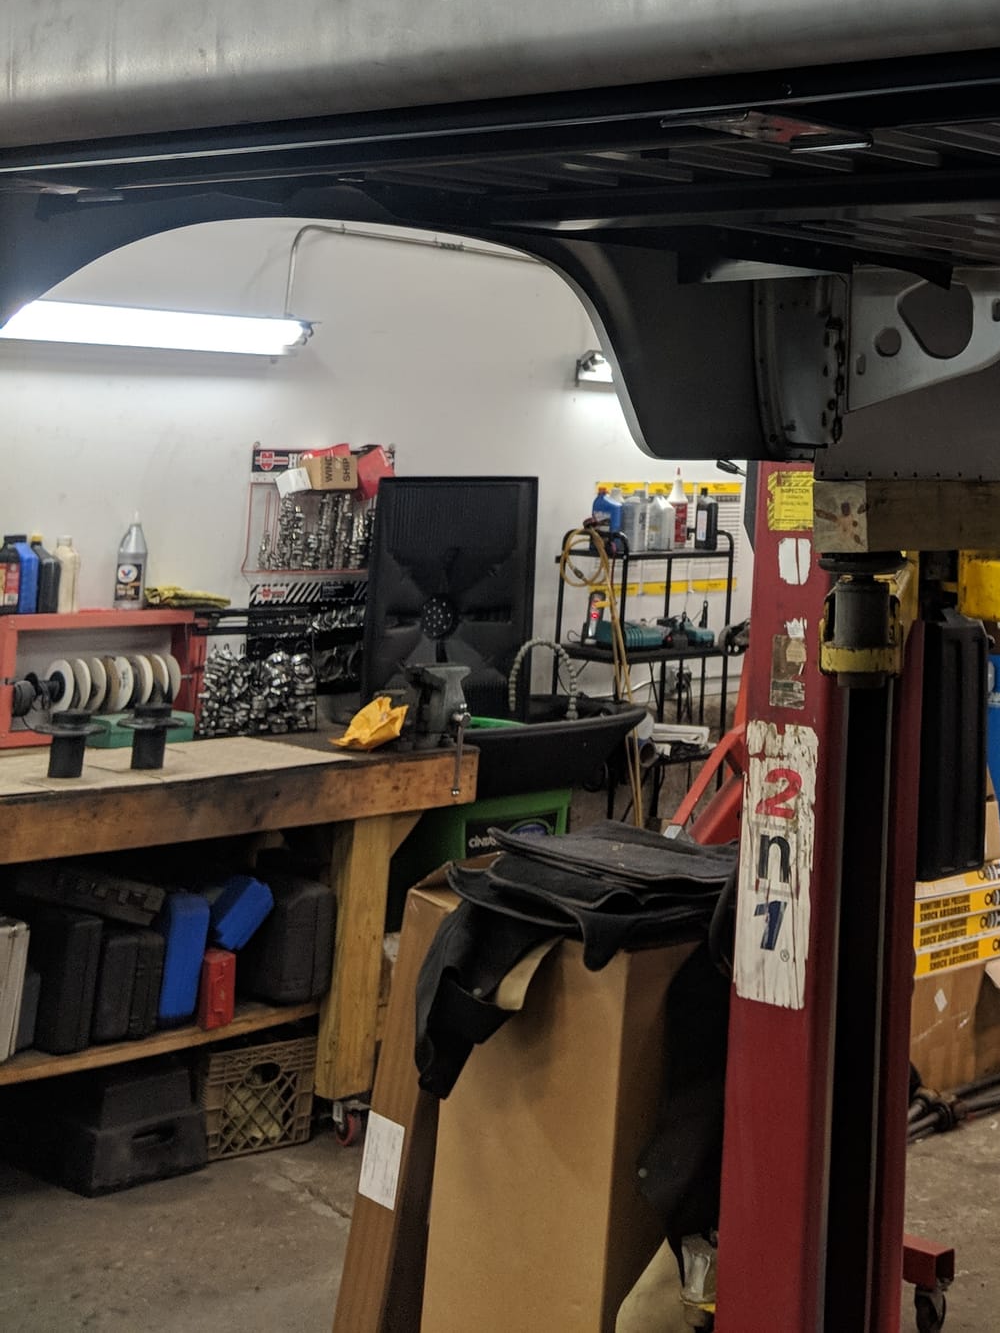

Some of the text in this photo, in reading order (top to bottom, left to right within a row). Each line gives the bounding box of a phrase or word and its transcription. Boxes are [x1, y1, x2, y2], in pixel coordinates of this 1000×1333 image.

[755, 767, 803, 820] 2
[754, 899, 788, 952] 1
[919, 904, 971, 923] SHOCK ABSORBERS
